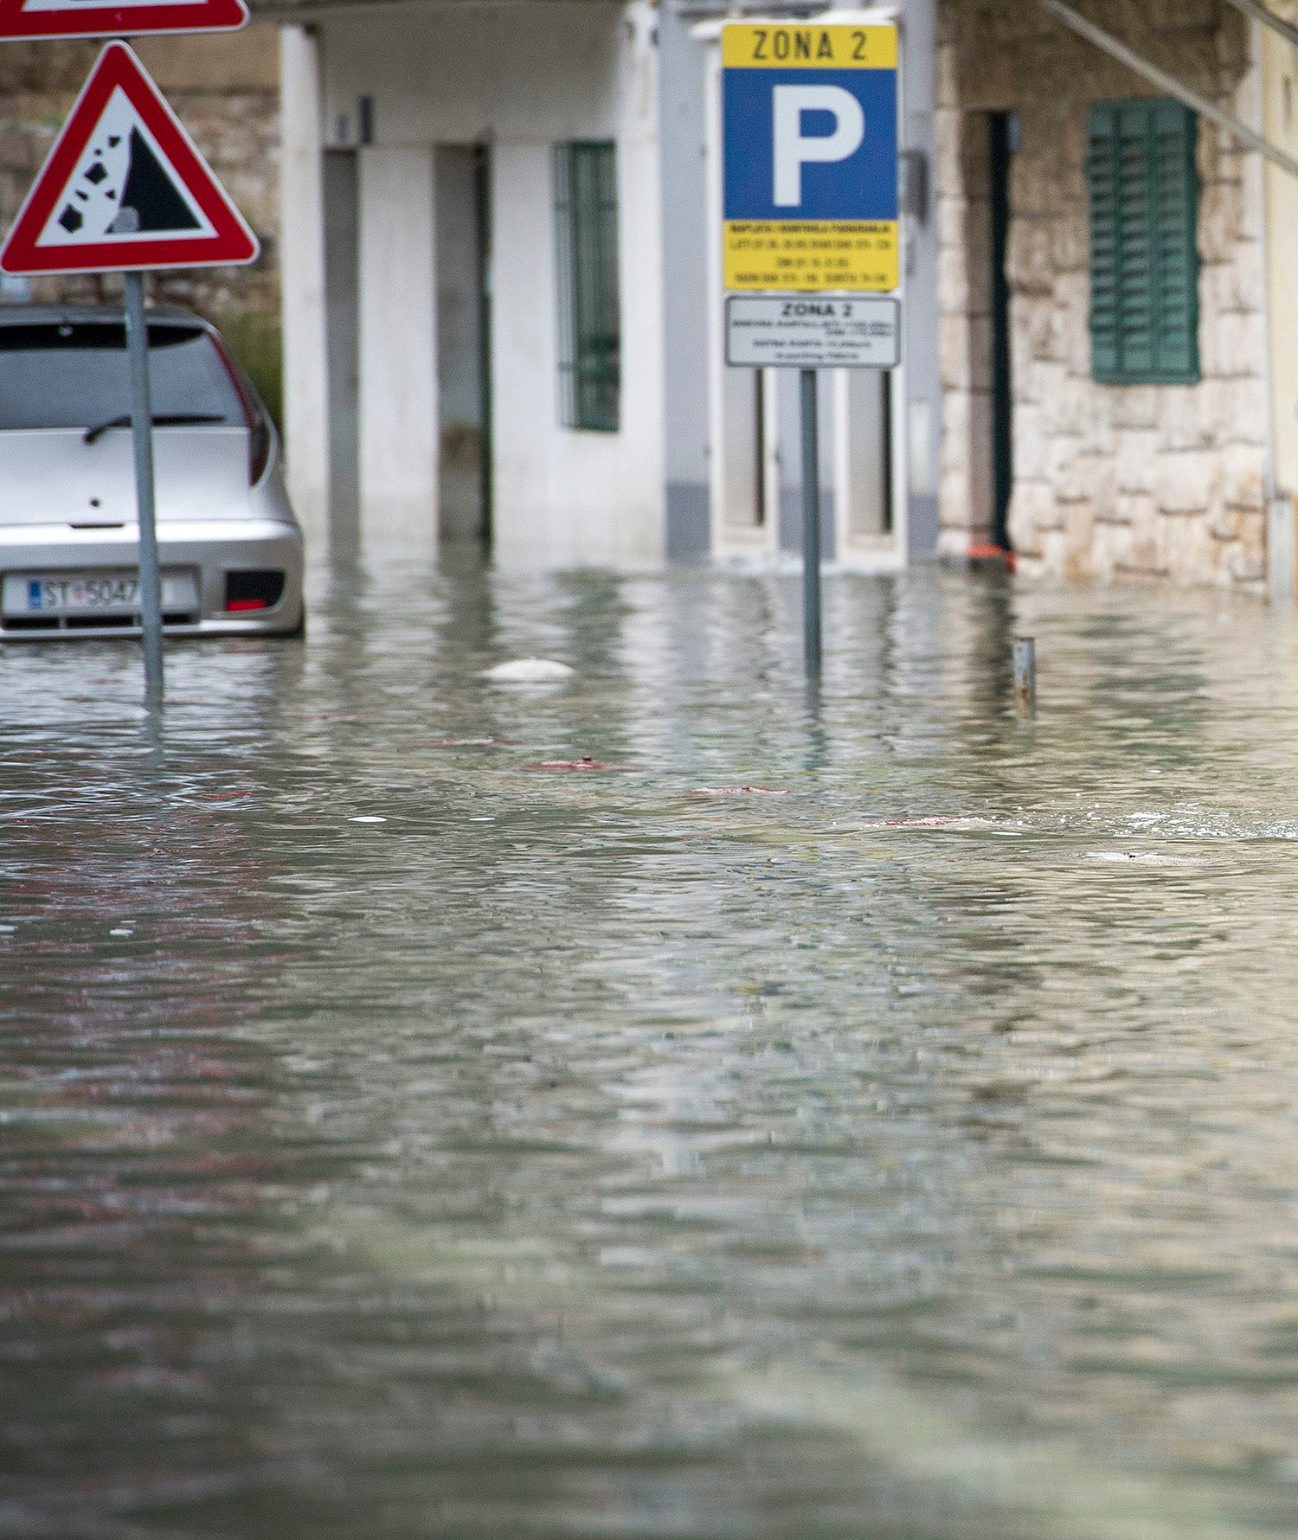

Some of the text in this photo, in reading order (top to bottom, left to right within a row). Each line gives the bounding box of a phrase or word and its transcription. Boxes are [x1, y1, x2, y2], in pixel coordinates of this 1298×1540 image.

[752, 30, 867, 61] ZONA 2
[772, 84, 865, 208] P
[781, 303, 853, 317] ZONA 2
[44, 581, 69, 607] ST
